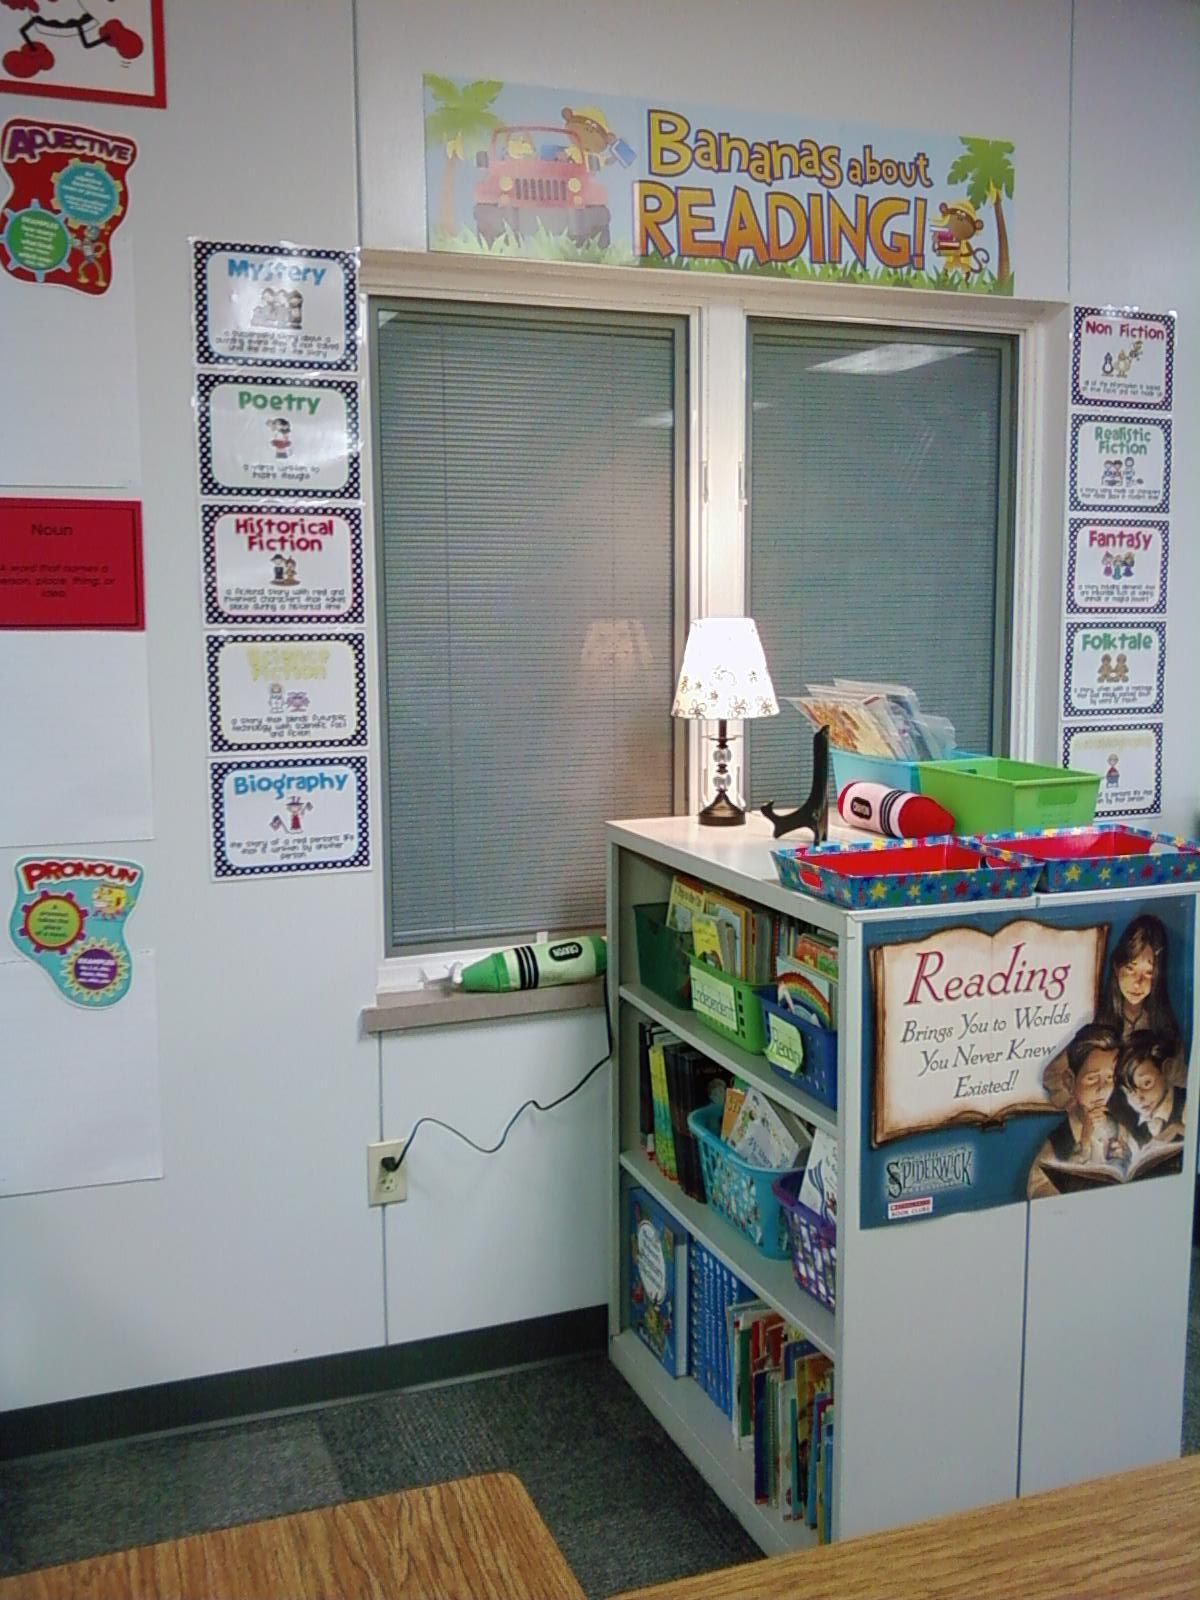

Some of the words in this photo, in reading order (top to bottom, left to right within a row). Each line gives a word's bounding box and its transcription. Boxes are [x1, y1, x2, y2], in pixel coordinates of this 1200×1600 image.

[6, 127, 132, 161] ADJECTIVE
[648, 109, 842, 189] Bananas
[847, 145, 934, 188] about
[633, 180, 928, 271] READING!
[228, 258, 326, 286] Mystery
[1086, 320, 1112, 336] Non
[1120, 323, 1164, 341] Fiction
[238, 391, 321, 415] Poetry
[1094, 426, 1152, 443] Realistic
[1098, 440, 1148, 456] Fiction
[31, 523, 73, 536] Noun
[235, 517, 334, 537] Historical
[1088, 529, 1153, 551] Fantasy
[247, 534, 323, 552] Fiction
[1082, 632, 1153, 651] Folktale
[233, 772, 349, 800] Biography
[22, 861, 138, 891] PRONOUN
[903, 942, 1072, 1006] Reading
[900, 1020, 953, 1043] Brings
[958, 1012, 989, 1040] You
[993, 1017, 1007, 1032] to
[1015, 1002, 1071, 1029] Worlds
[917, 1049, 949, 1077] You
[951, 1043, 1004, 1068] Never
[1006, 1038, 1057, 1061] Knew
[953, 1069, 1020, 1099] Existed!
[886, 1150, 973, 1199] SPIDERWICK
